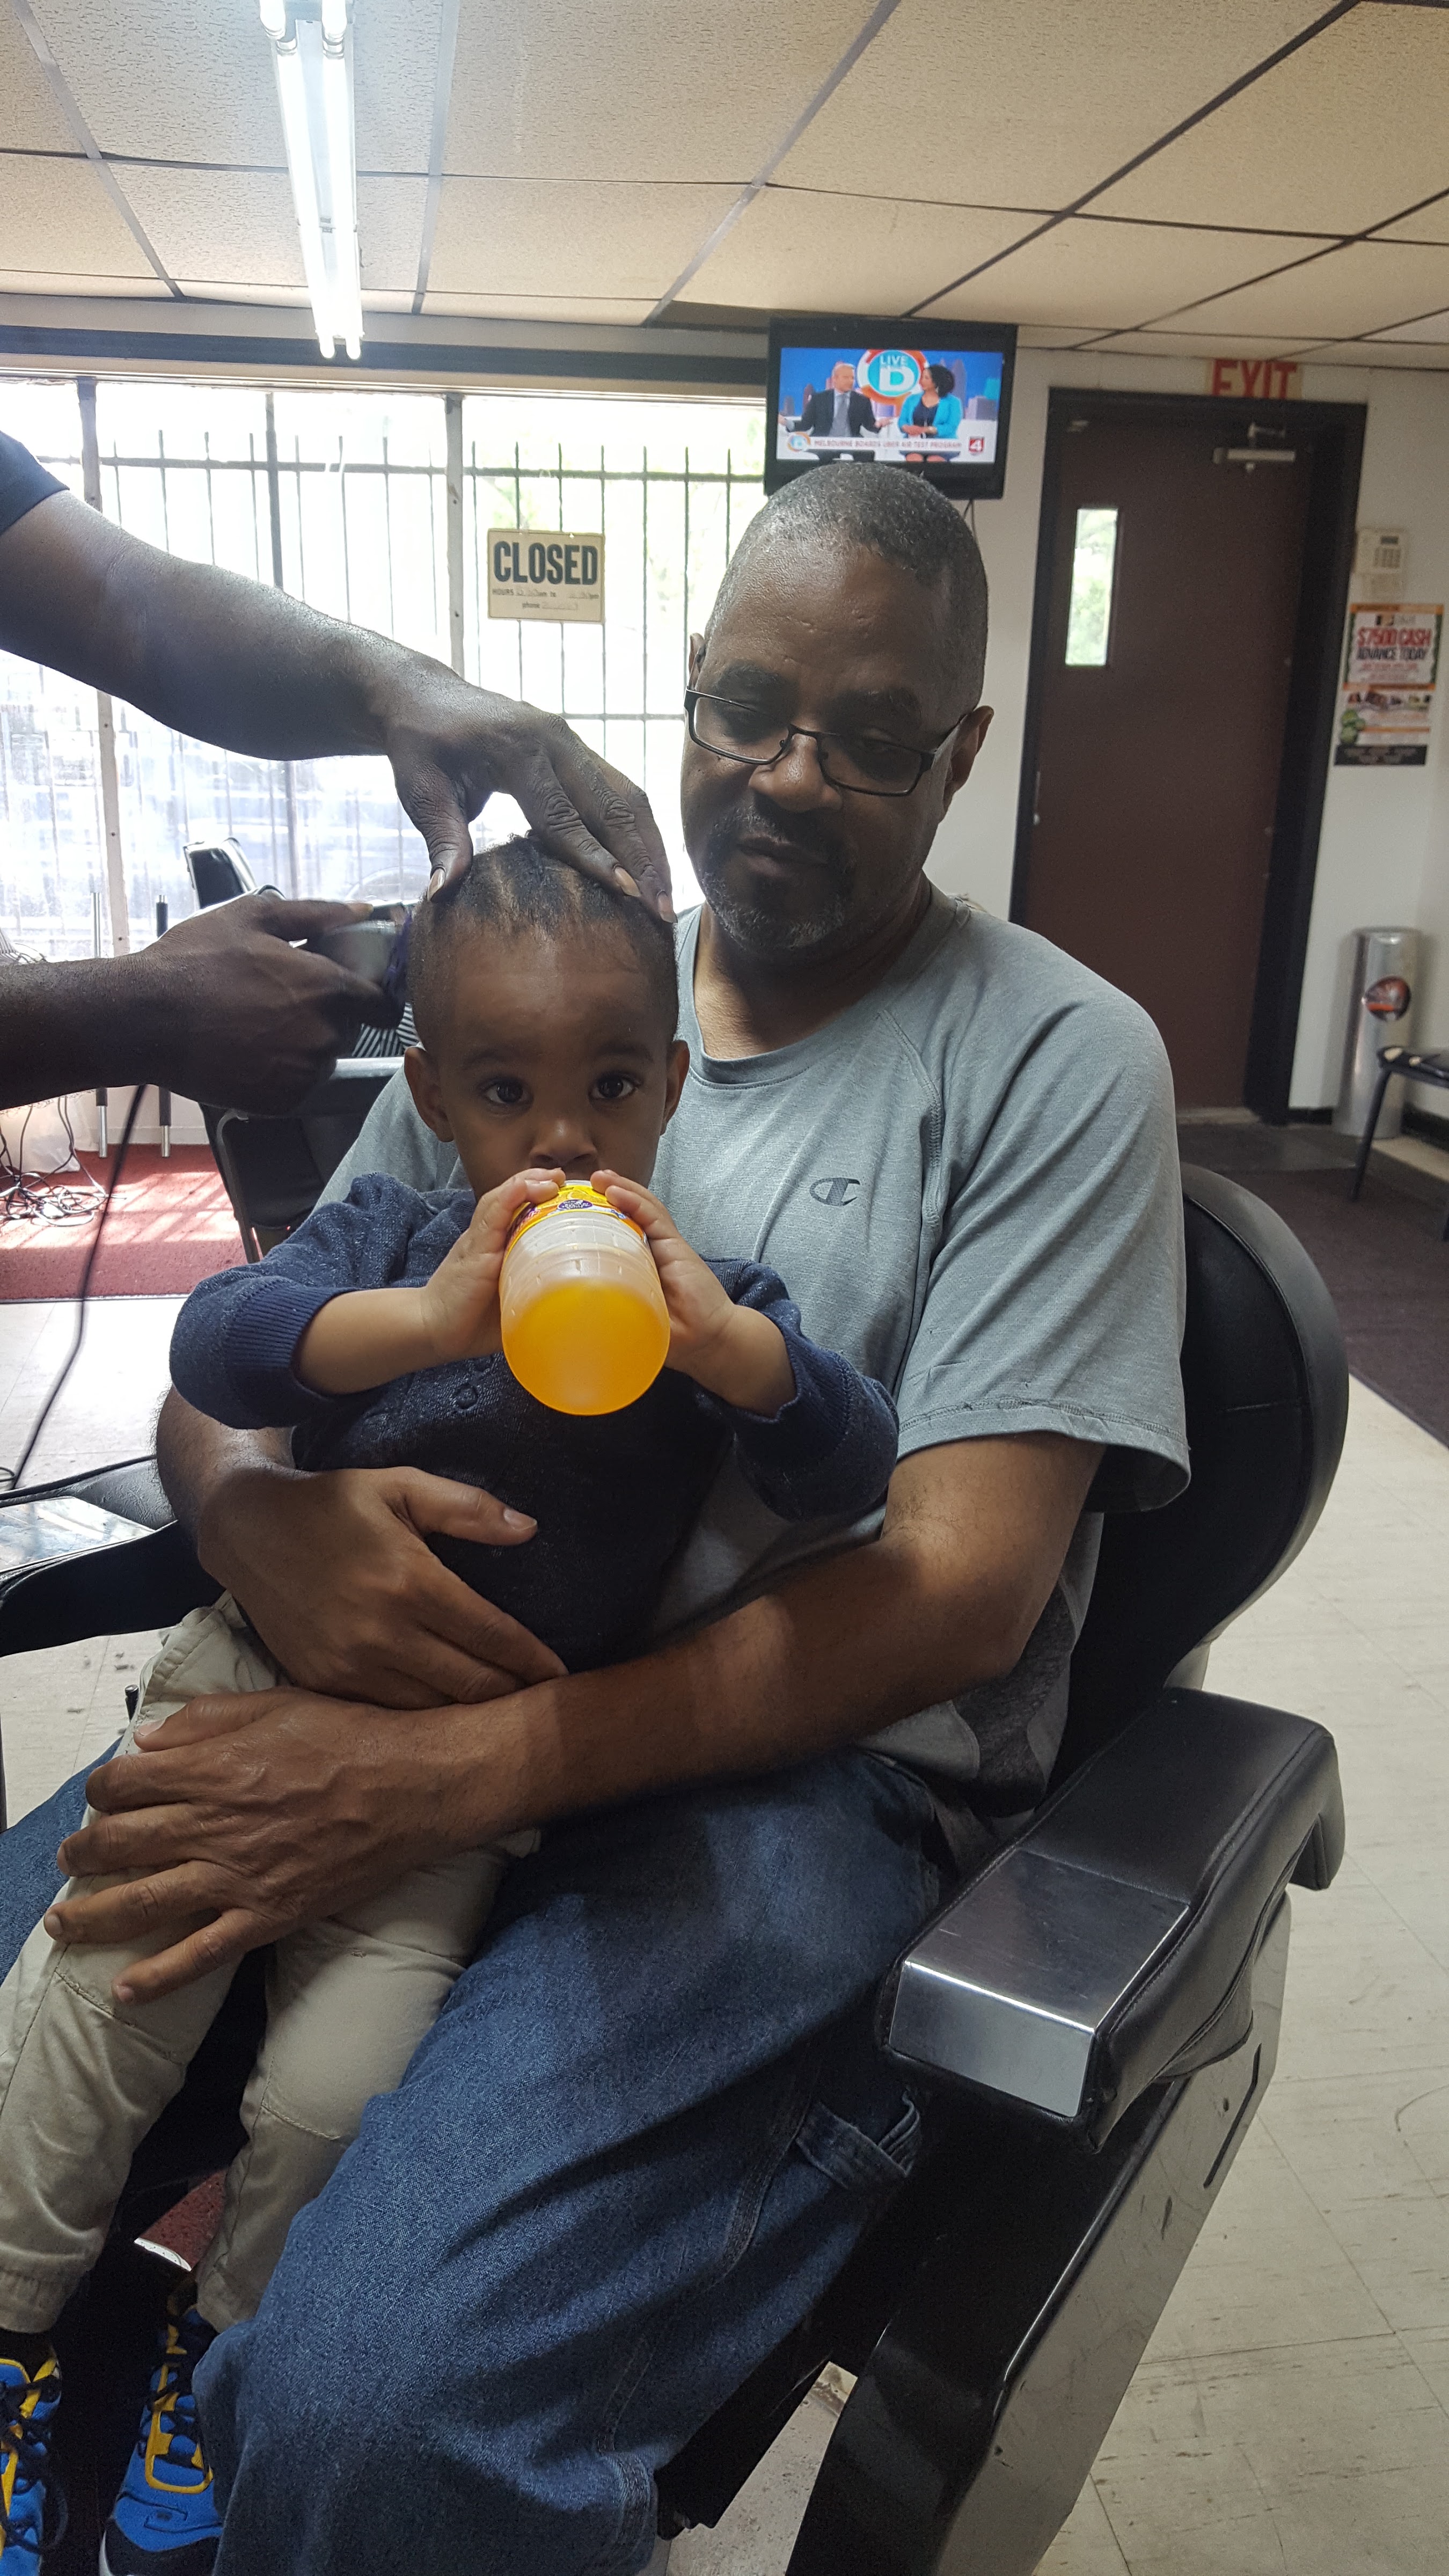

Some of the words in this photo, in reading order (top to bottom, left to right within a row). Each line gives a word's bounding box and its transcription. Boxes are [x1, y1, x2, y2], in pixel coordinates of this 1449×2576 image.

[880, 355, 906, 364] LIVE
[880, 366, 914, 391] D
[1212, 359, 1298, 399] EXIT
[970, 439, 982, 451] 4
[494, 541, 598, 585] CLOSED
[1400, 628, 1432, 647] CASH
[1357, 647, 1395, 660] ADVANCE
